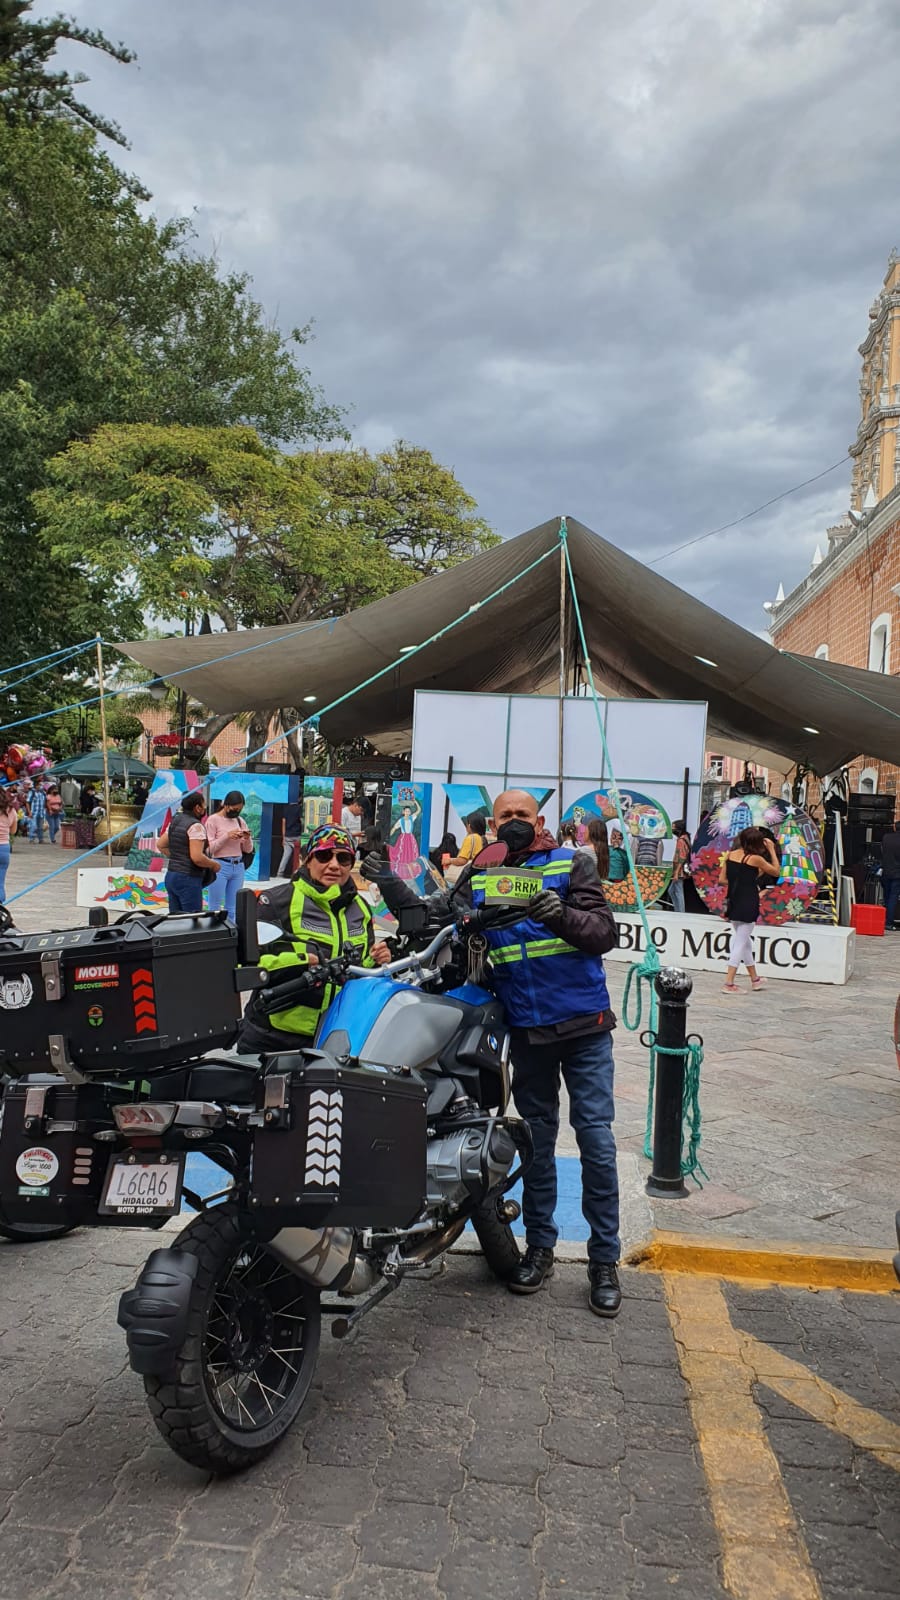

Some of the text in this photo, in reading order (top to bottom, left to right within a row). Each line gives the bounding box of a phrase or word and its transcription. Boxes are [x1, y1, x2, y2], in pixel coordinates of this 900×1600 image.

[515, 881, 538, 895] RRM
[78, 964, 118, 979] MOTUL
[116, 1171, 169, 1196] L6CA6
[122, 1197, 159, 1205] HIDALGO
[117, 1206, 154, 1214] MOTO SHOP
